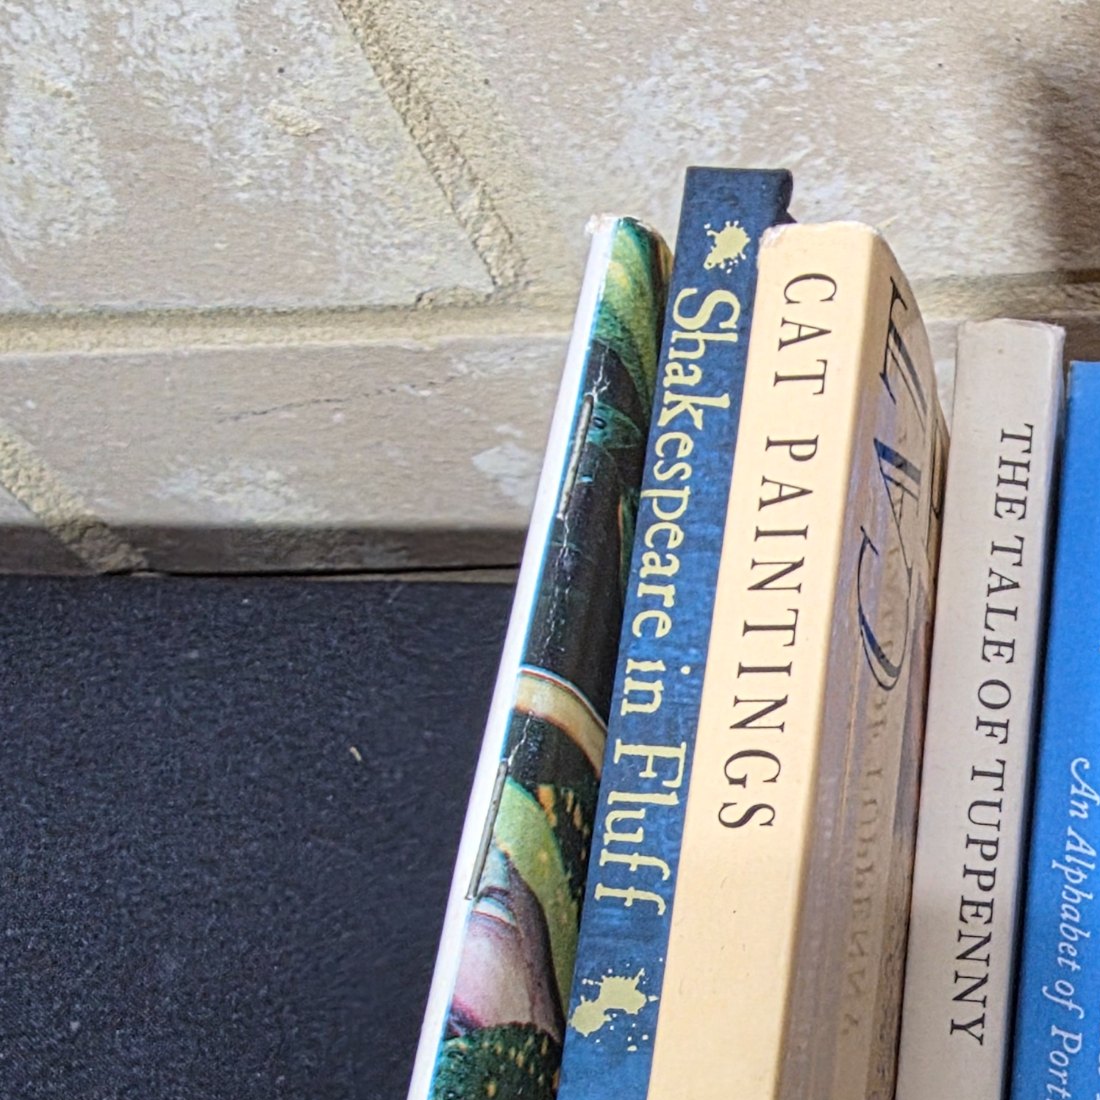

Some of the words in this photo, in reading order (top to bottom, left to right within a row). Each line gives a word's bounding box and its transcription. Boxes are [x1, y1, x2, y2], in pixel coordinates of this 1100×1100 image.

[773, 273, 838, 395] CAT
[634, 287, 741, 641] Shakespeare
[993, 423, 1035, 520] THE
[717, 434, 819, 829] PAINTINGS
[980, 535, 1025, 665] TALE
[622, 665, 694, 716] in
[975, 679, 1013, 745] OF
[594, 741, 688, 916] Fluff
[1067, 757, 1100, 820] An
[949, 759, 1006, 1046] TUPPENNY
[1052, 827, 1097, 972] Alphabet
[1042, 977, 1084, 1021] of
